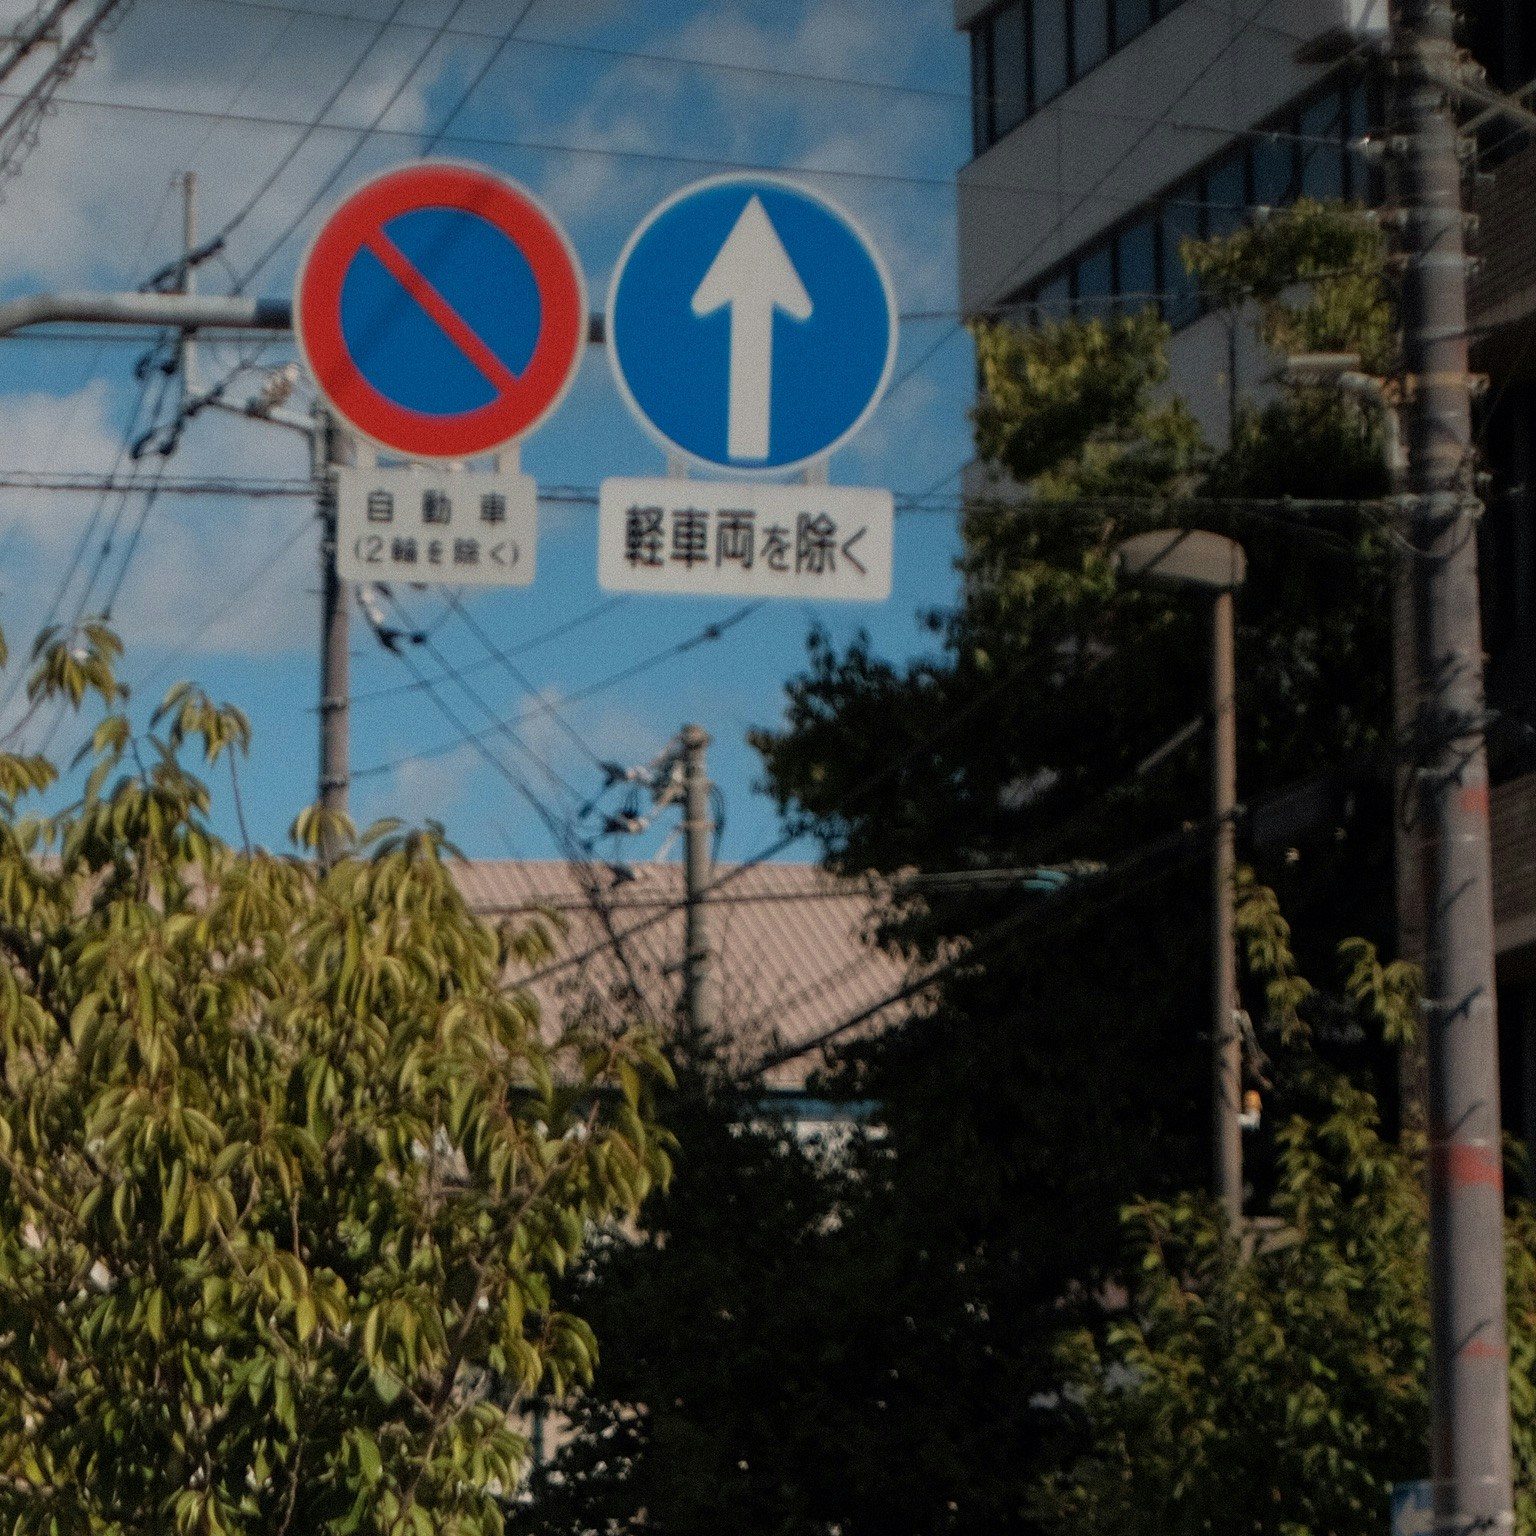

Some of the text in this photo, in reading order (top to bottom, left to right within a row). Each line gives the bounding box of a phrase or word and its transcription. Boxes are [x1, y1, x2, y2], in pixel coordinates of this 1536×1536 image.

[367, 487, 507, 526] 自動車
[625, 503, 867, 576] 軽車両を除く
